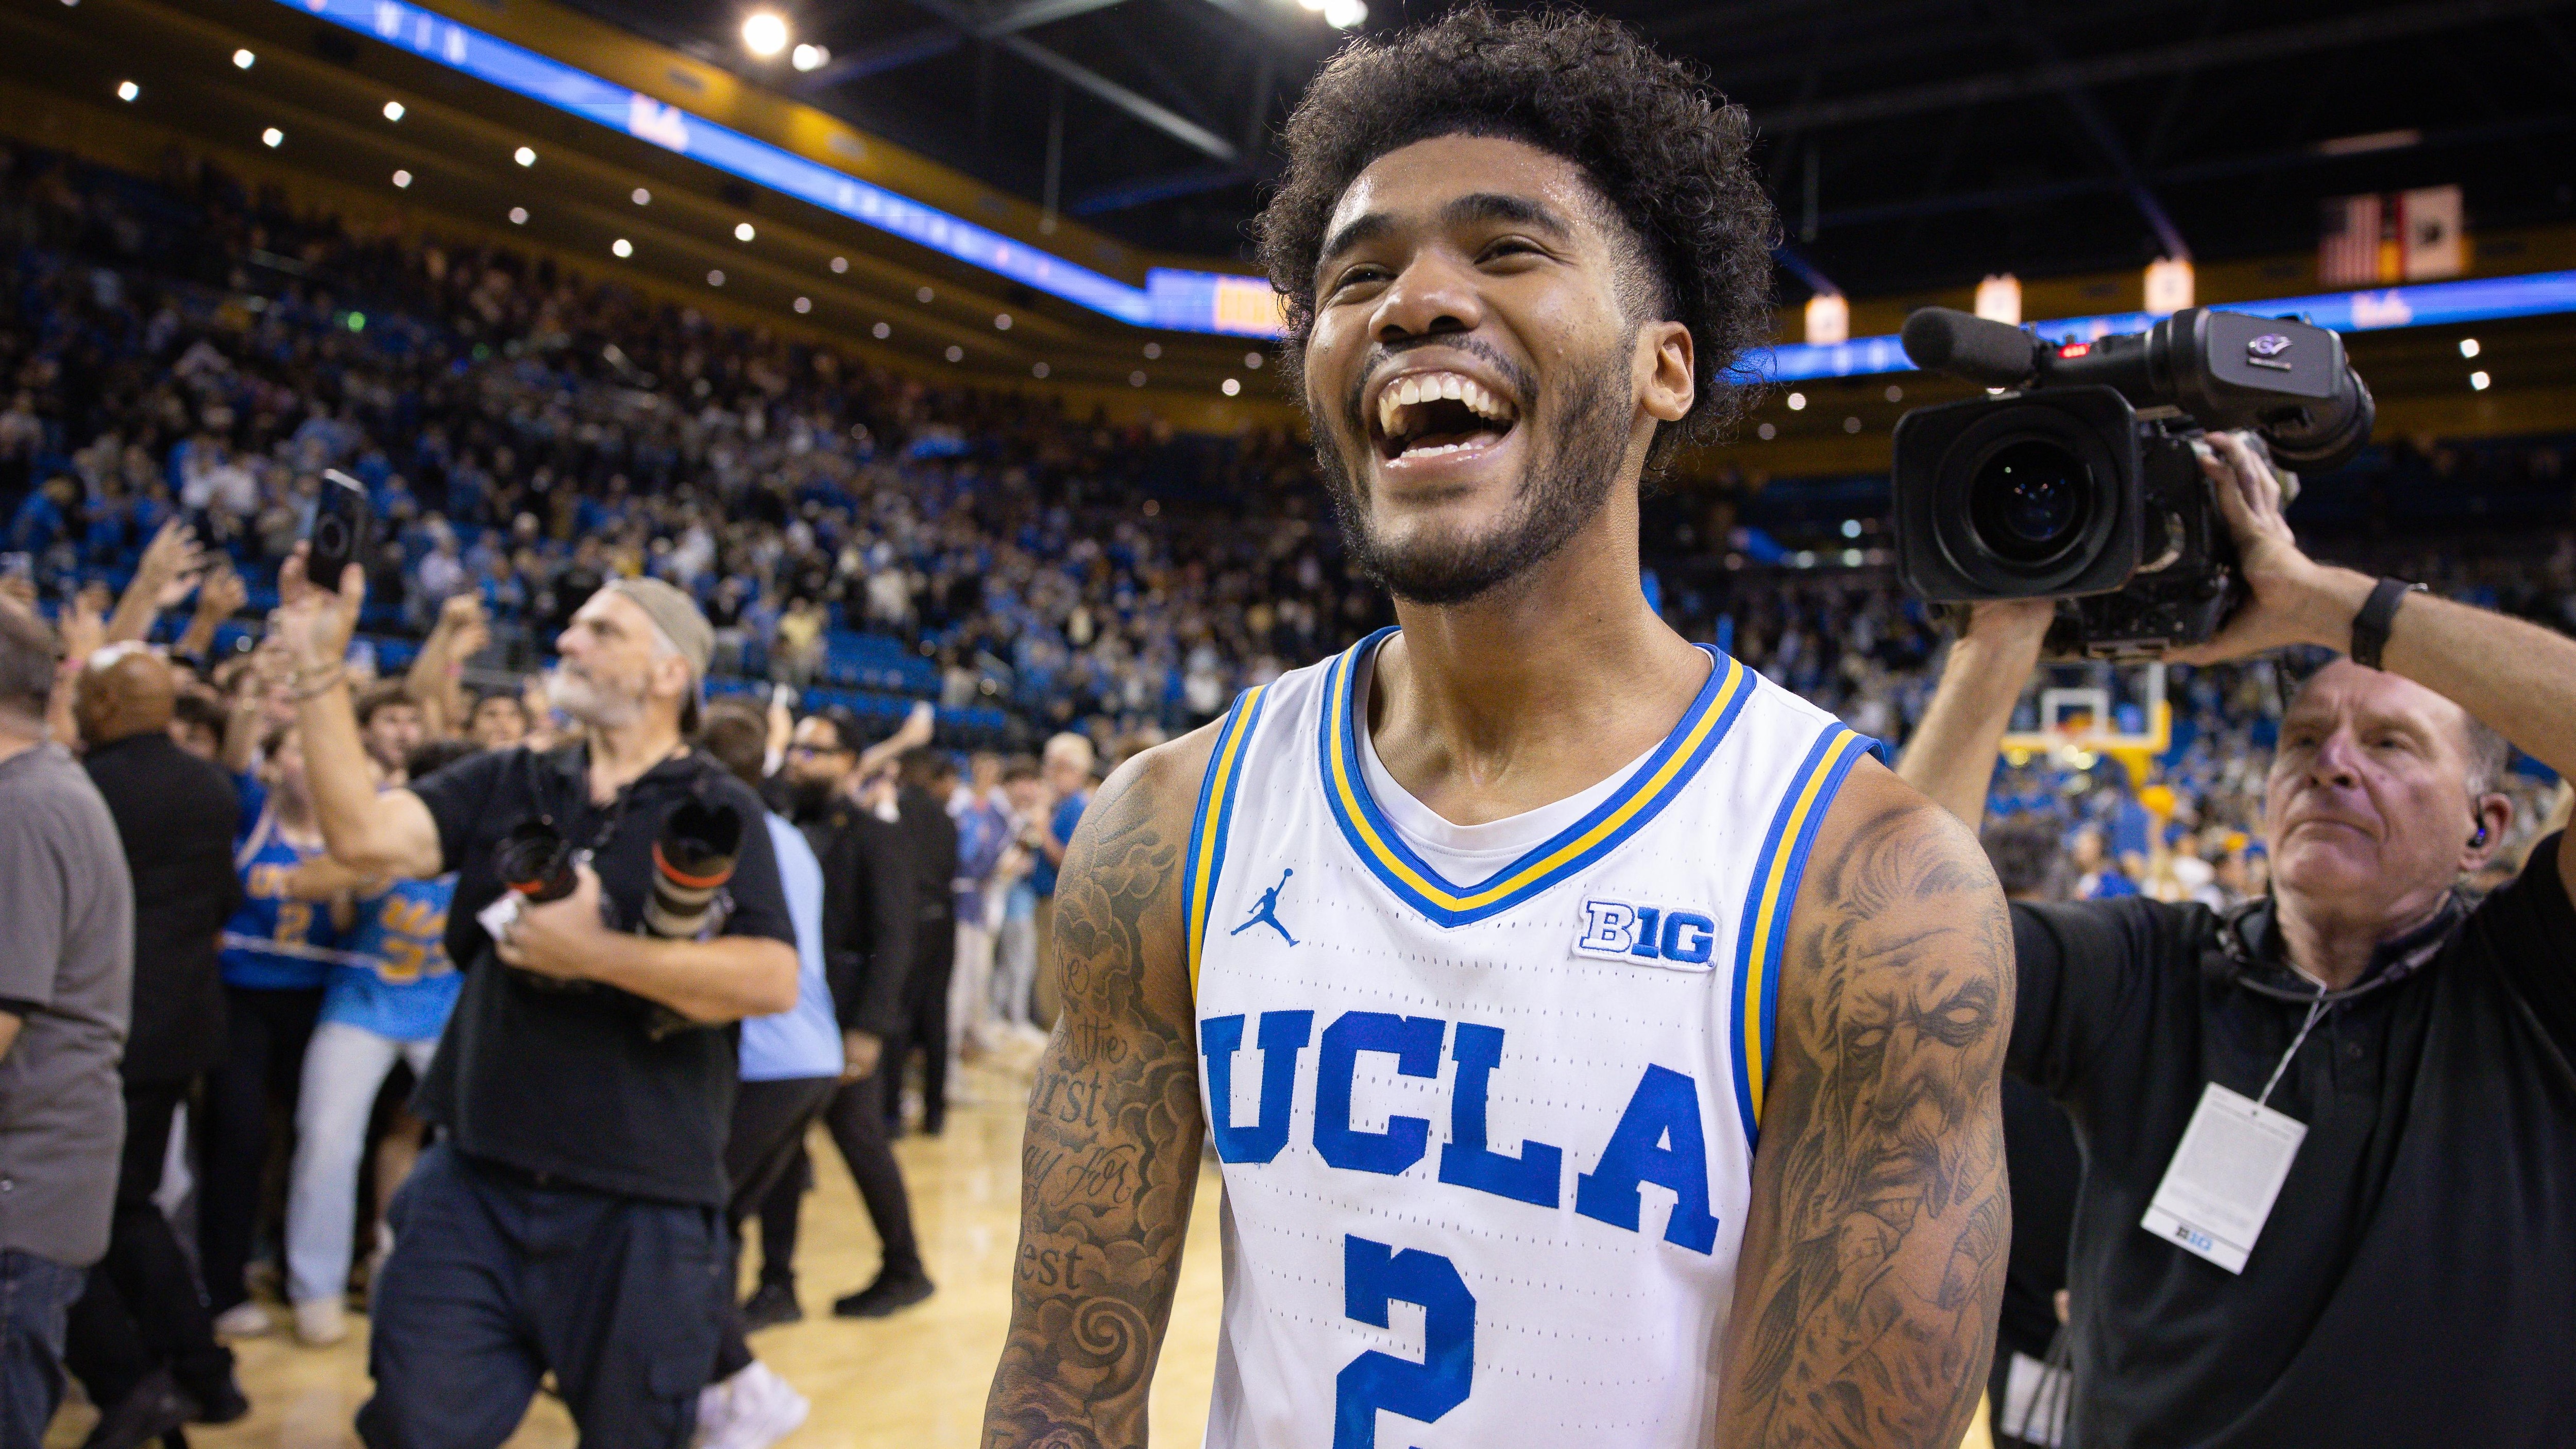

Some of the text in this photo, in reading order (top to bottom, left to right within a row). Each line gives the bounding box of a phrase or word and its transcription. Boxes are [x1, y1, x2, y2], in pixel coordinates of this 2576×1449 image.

[1077, 1015, 1128, 1065] the
[1200, 1010, 1719, 1256] UCLA
[1016, 1240, 1083, 1290] est
[1333, 1233, 1477, 1449] 2
